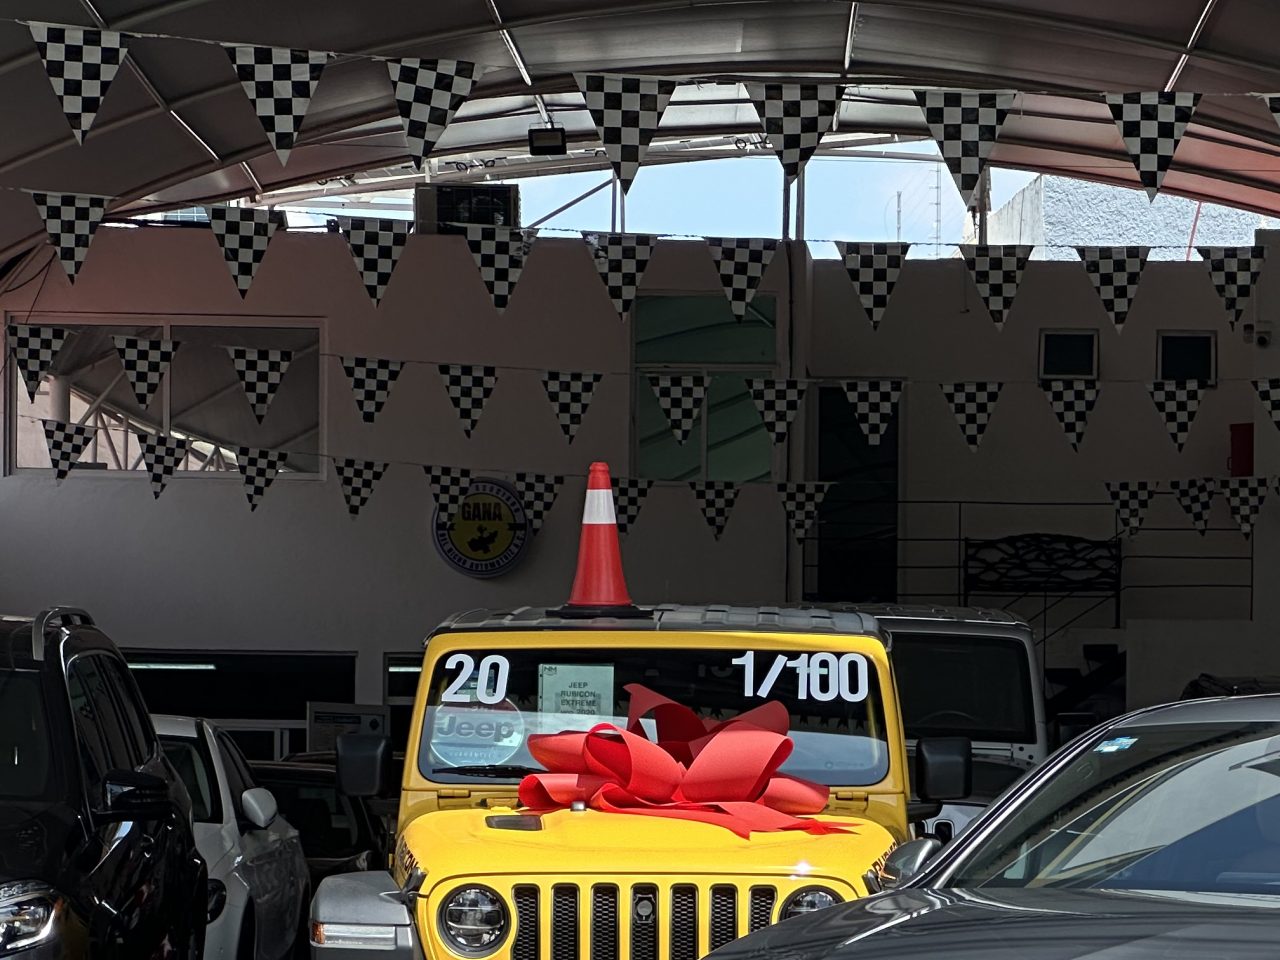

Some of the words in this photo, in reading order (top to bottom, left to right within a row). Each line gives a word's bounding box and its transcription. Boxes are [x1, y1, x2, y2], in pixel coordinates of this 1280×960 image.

[461, 502, 503, 521] GANA
[469, 548, 514, 570] AUTOMOTRIZ
[441, 653, 510, 704] 20
[732, 651, 868, 702] 1/100
[560, 690, 596, 698] RUBICON
[560, 699, 597, 707] EXTREME
[437, 715, 515, 742] Jeep
